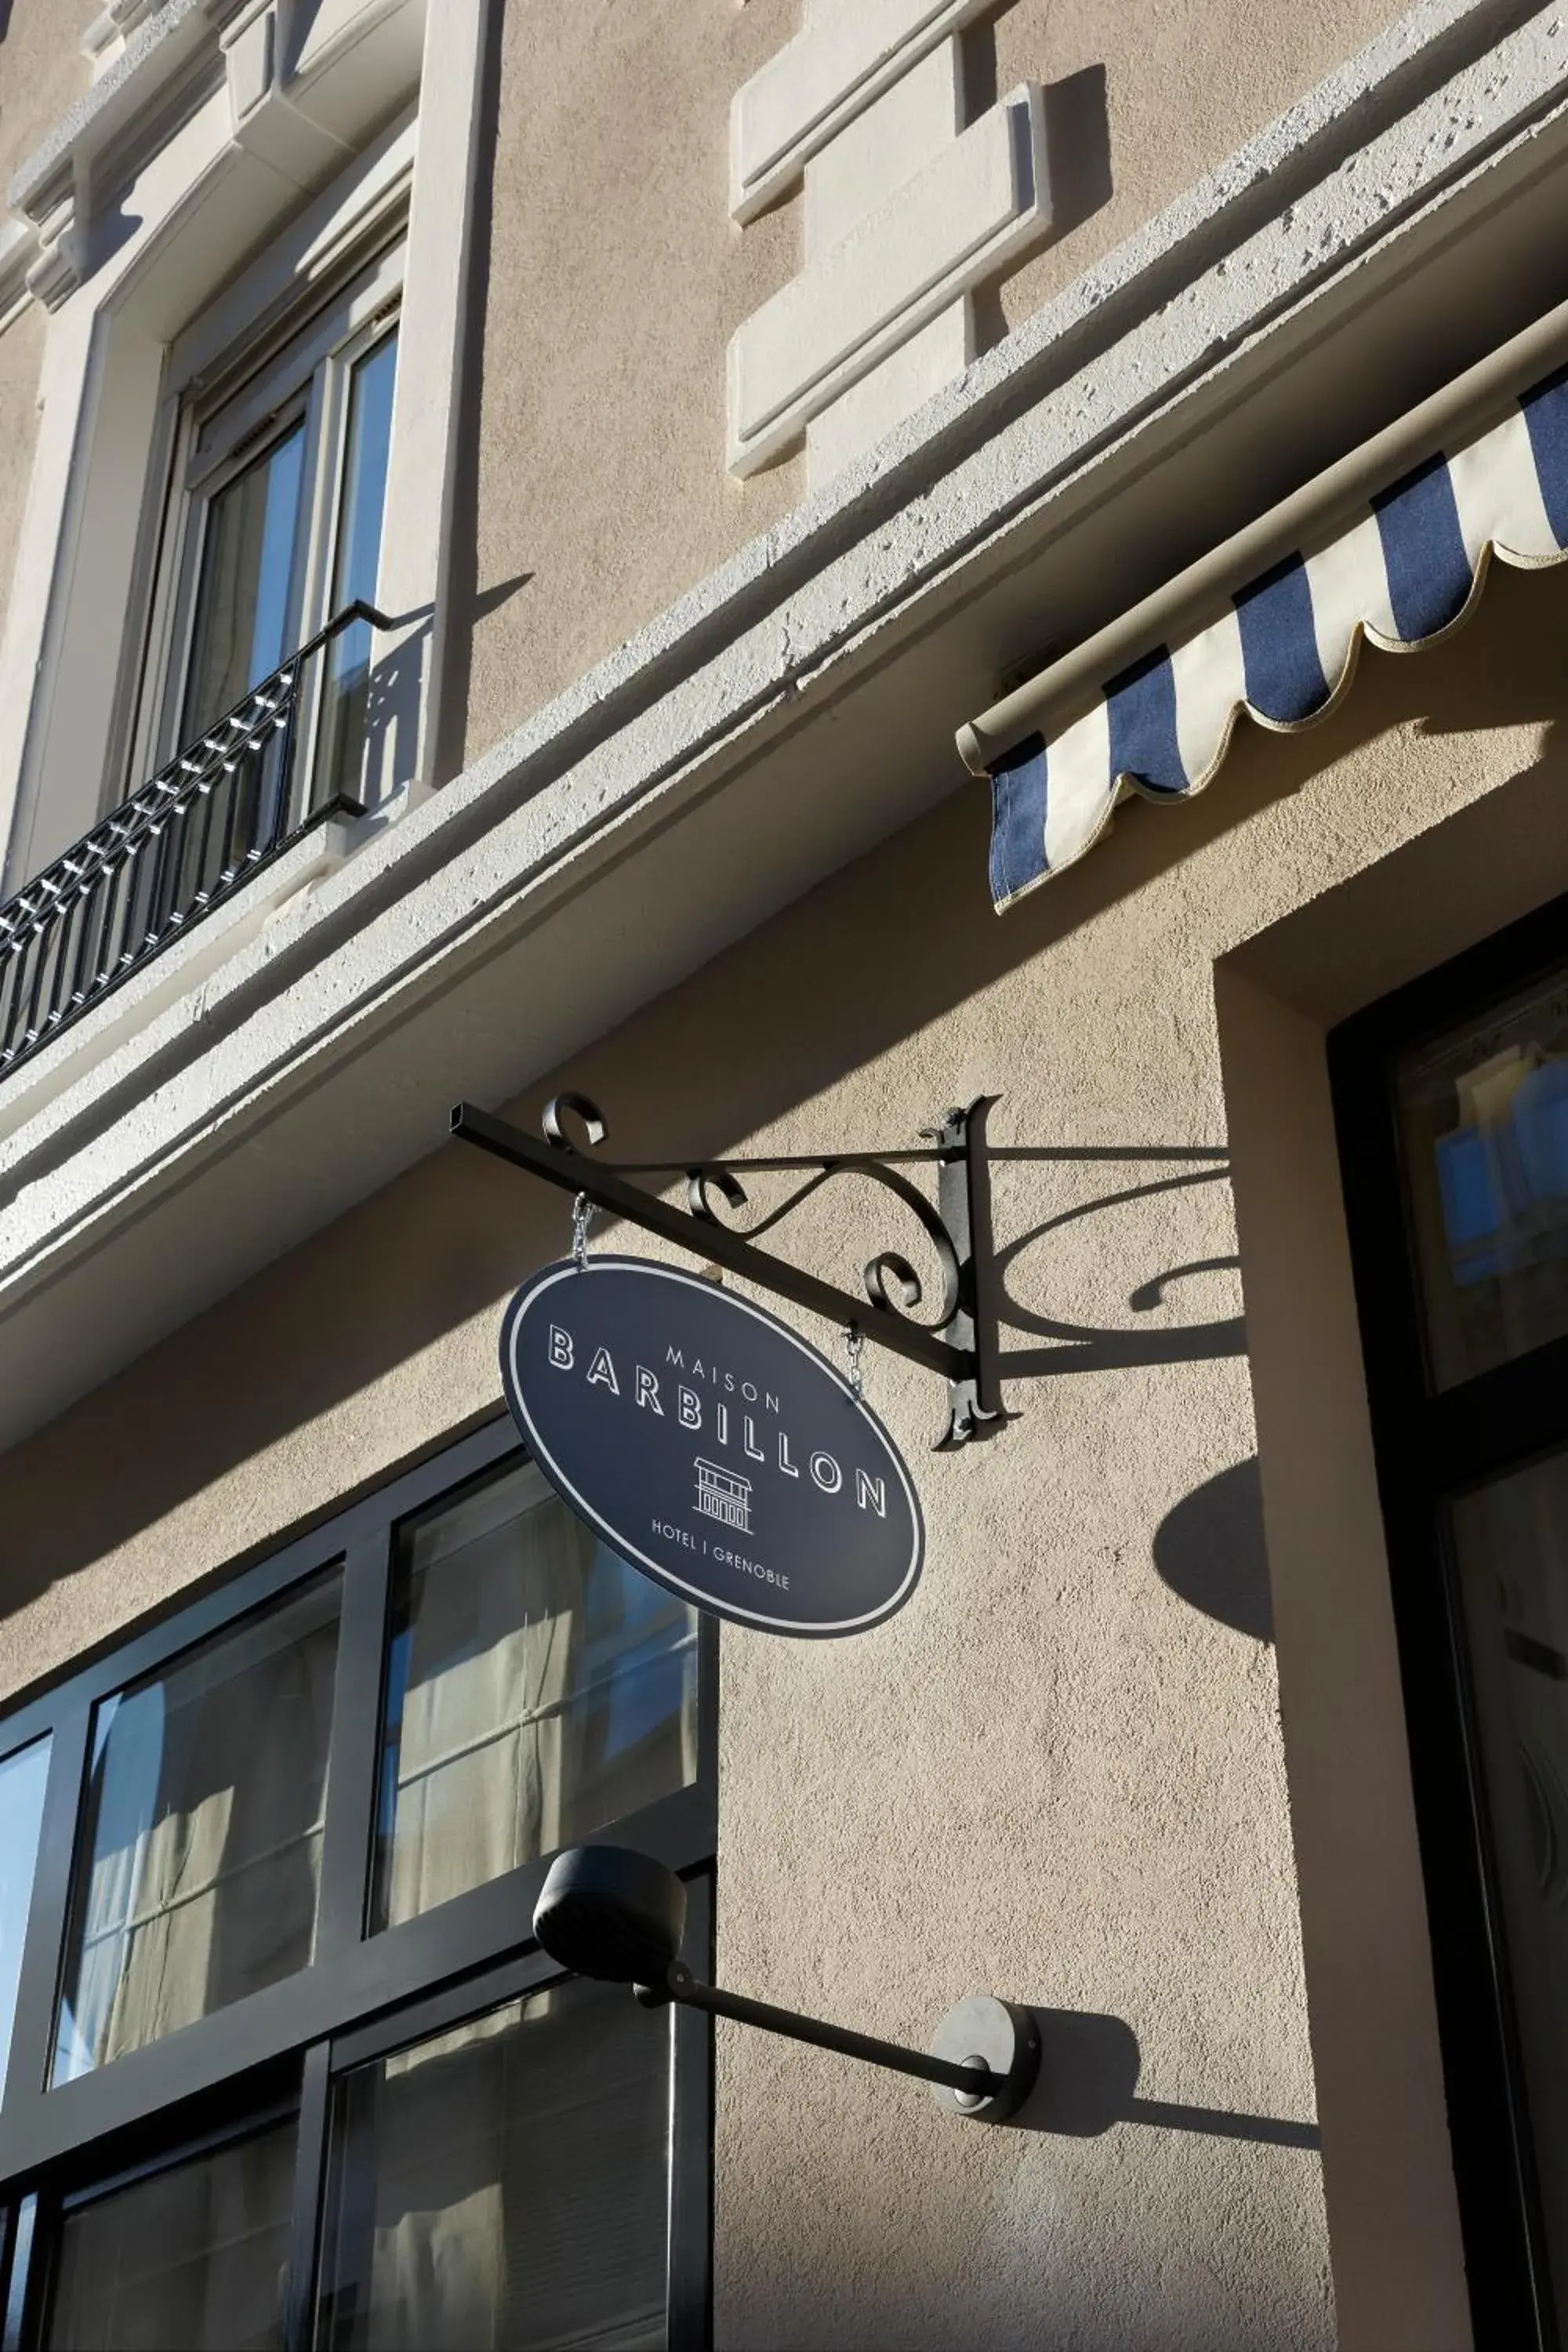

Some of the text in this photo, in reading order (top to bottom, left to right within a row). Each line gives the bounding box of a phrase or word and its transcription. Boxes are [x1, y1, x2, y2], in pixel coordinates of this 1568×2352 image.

[666, 1345, 779, 1414] MAISON
[548, 1323, 887, 1519] BARBILLON
[652, 1519, 790, 1591] HOTEL GRENOBLE
